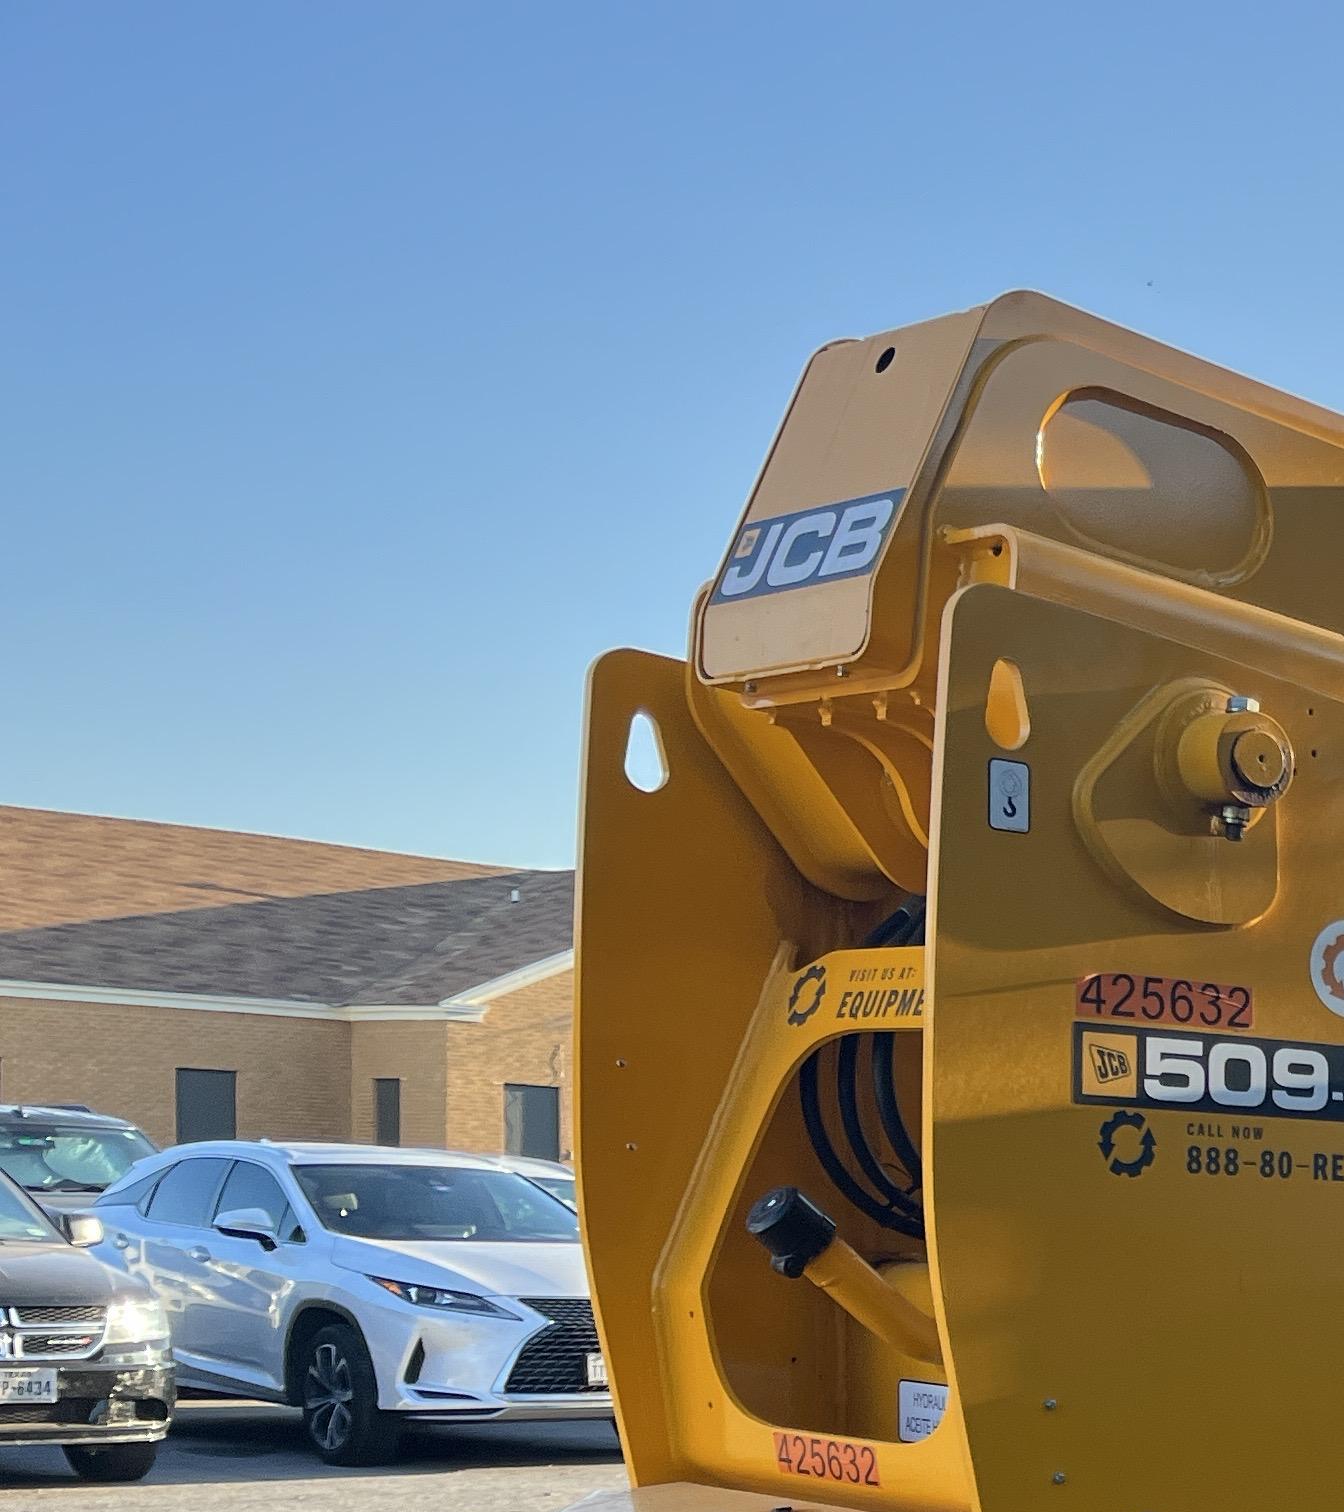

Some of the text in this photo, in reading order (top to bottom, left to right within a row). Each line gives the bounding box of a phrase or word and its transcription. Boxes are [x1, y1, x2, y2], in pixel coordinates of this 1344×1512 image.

[720, 499, 894, 597] JCB
[1080, 973, 1251, 1028] 425632
[1097, 1047, 1129, 1081] JCB
[1187, 1122, 1265, 1141] CALL NOW
[778, 1434, 880, 1486] 425632
